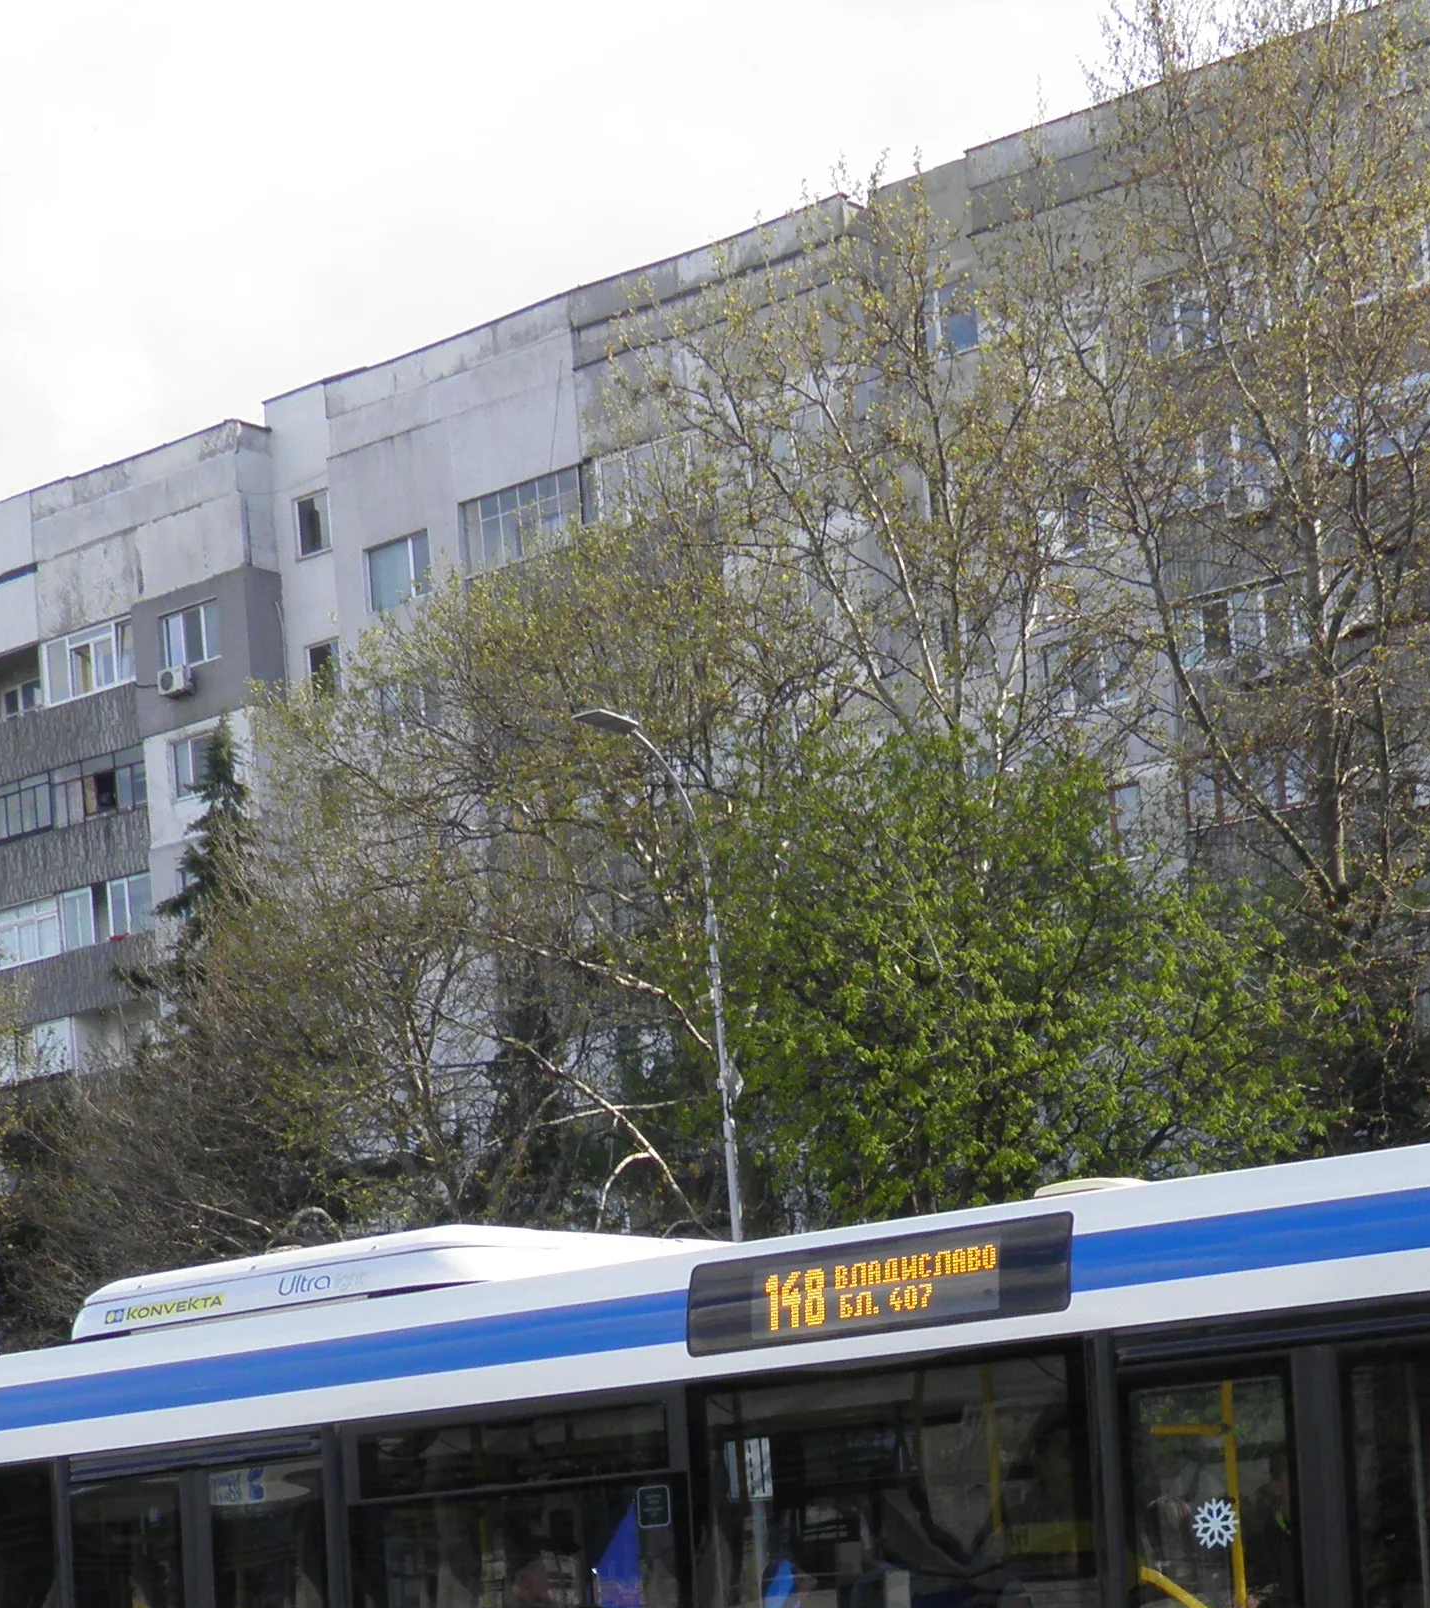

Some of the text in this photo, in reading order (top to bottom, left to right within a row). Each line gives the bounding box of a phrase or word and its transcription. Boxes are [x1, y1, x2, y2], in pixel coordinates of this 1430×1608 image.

[764, 1244, 998, 1331] 148 ВЛАДИСЛАВО
[889, 1283, 933, 1312] 407
[125, 1295, 223, 1321] KONVEKTA
